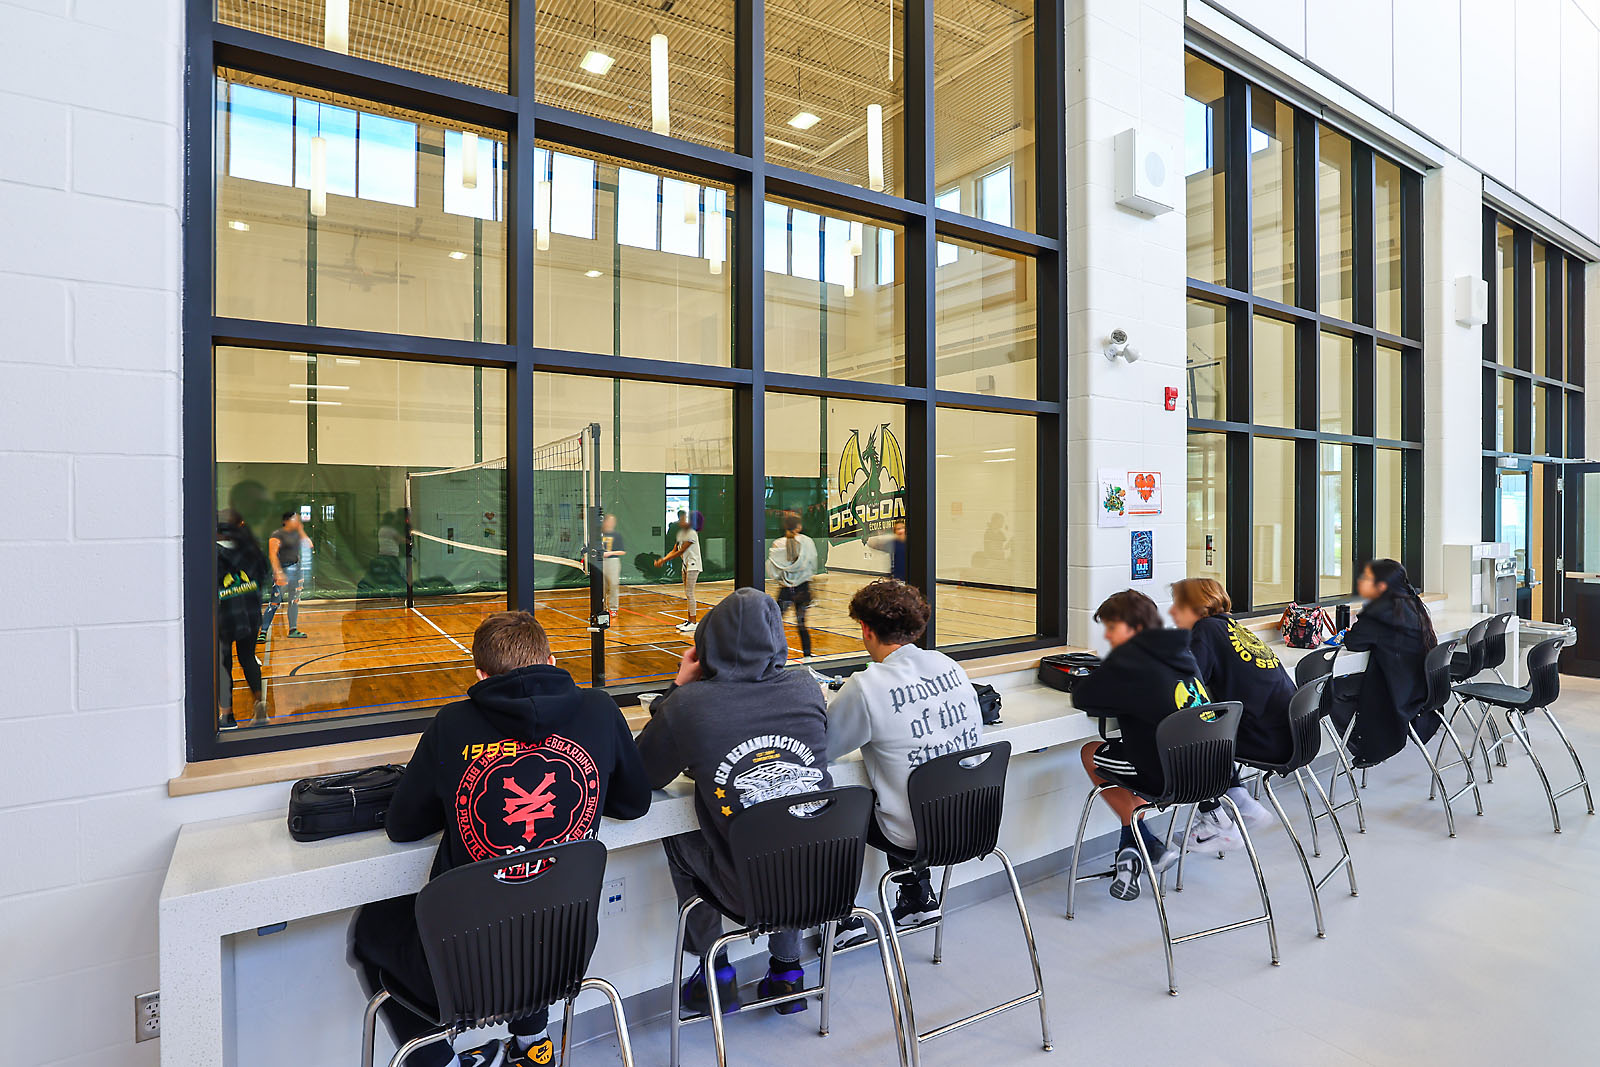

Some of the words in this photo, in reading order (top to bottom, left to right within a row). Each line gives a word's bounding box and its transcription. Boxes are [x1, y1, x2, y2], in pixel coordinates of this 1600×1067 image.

[1227, 622, 1252, 662] ONLY
[888, 665, 962, 714] product
[910, 707, 934, 739] of
[938, 700, 968, 730] the
[462, 742, 517, 760] 1993
[713, 762, 735, 786] OEM
[725, 734, 816, 767] REMANUFACTURING
[907, 722, 979, 769] streets
[458, 809, 487, 861] PRACTICE
